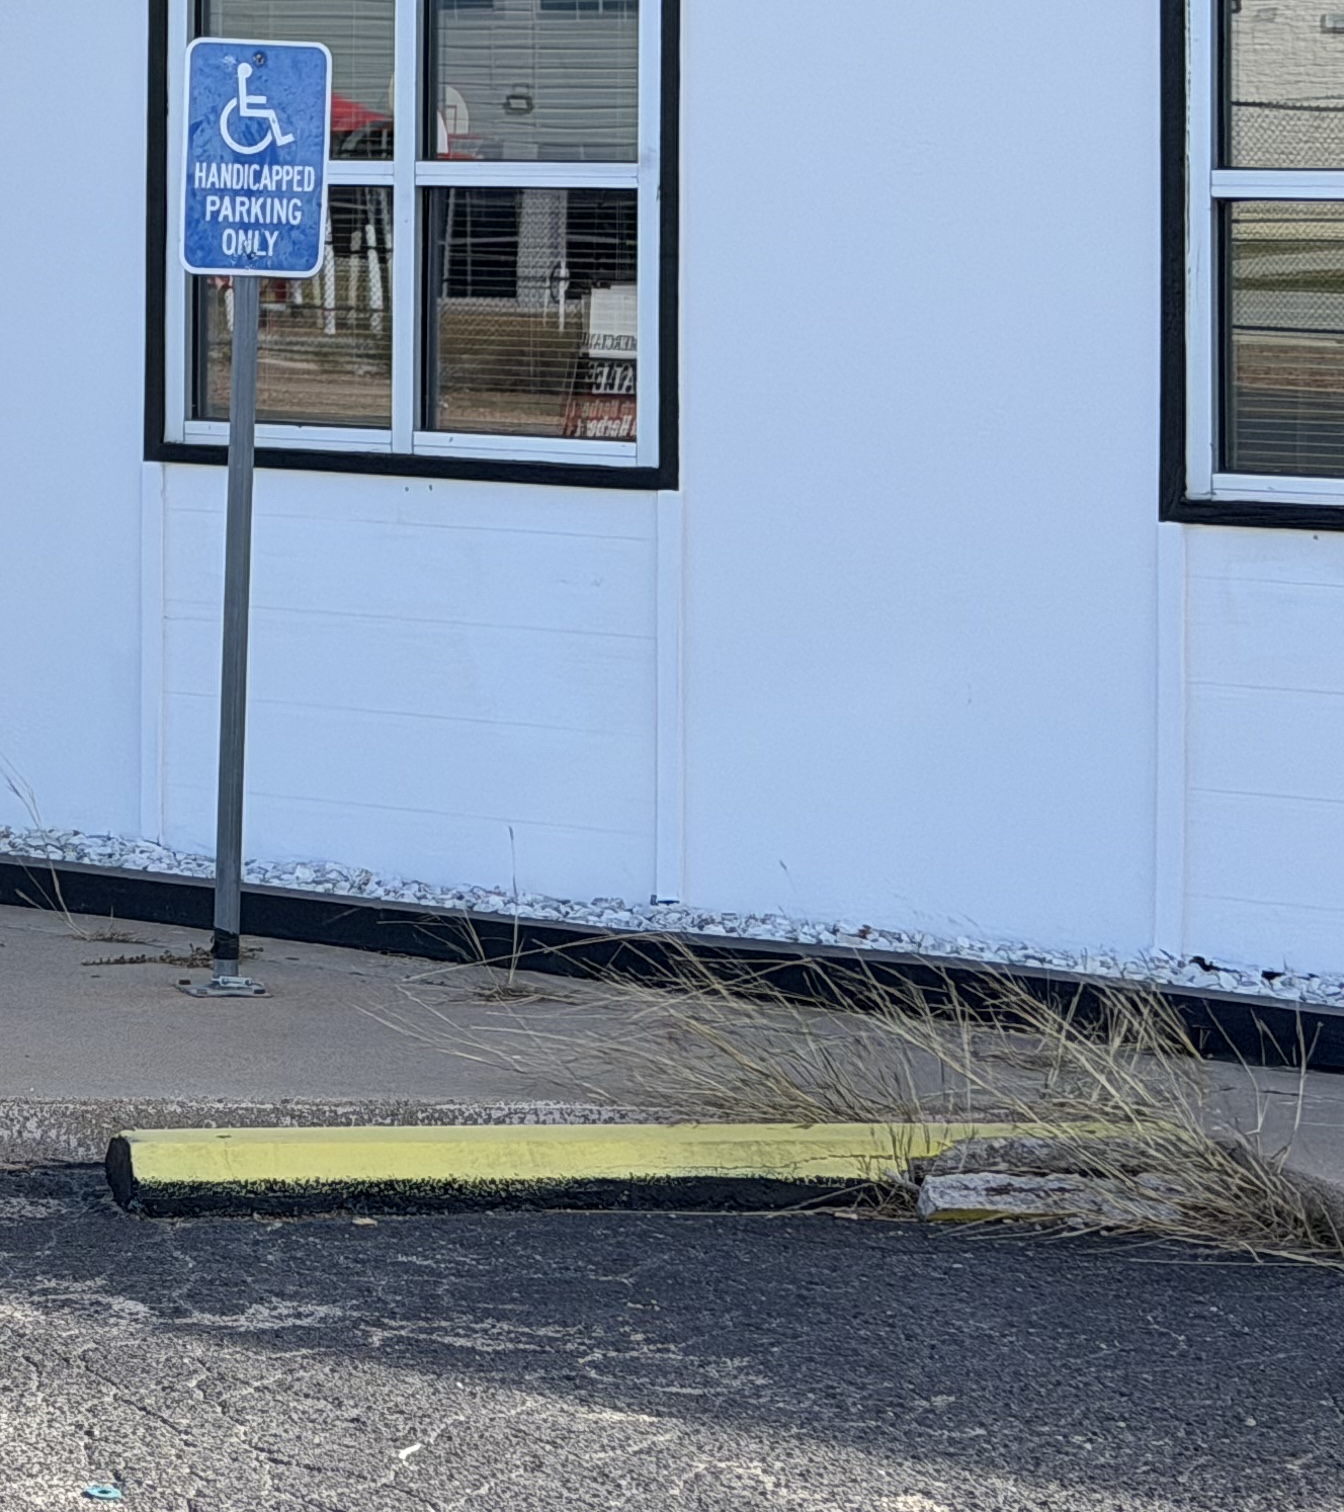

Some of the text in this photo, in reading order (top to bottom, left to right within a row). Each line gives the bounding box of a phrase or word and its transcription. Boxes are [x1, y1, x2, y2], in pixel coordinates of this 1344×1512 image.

[194, 161, 316, 192] HANDICAPPED
[205, 195, 303, 225] PARKING
[222, 228, 279, 257] ONLY
